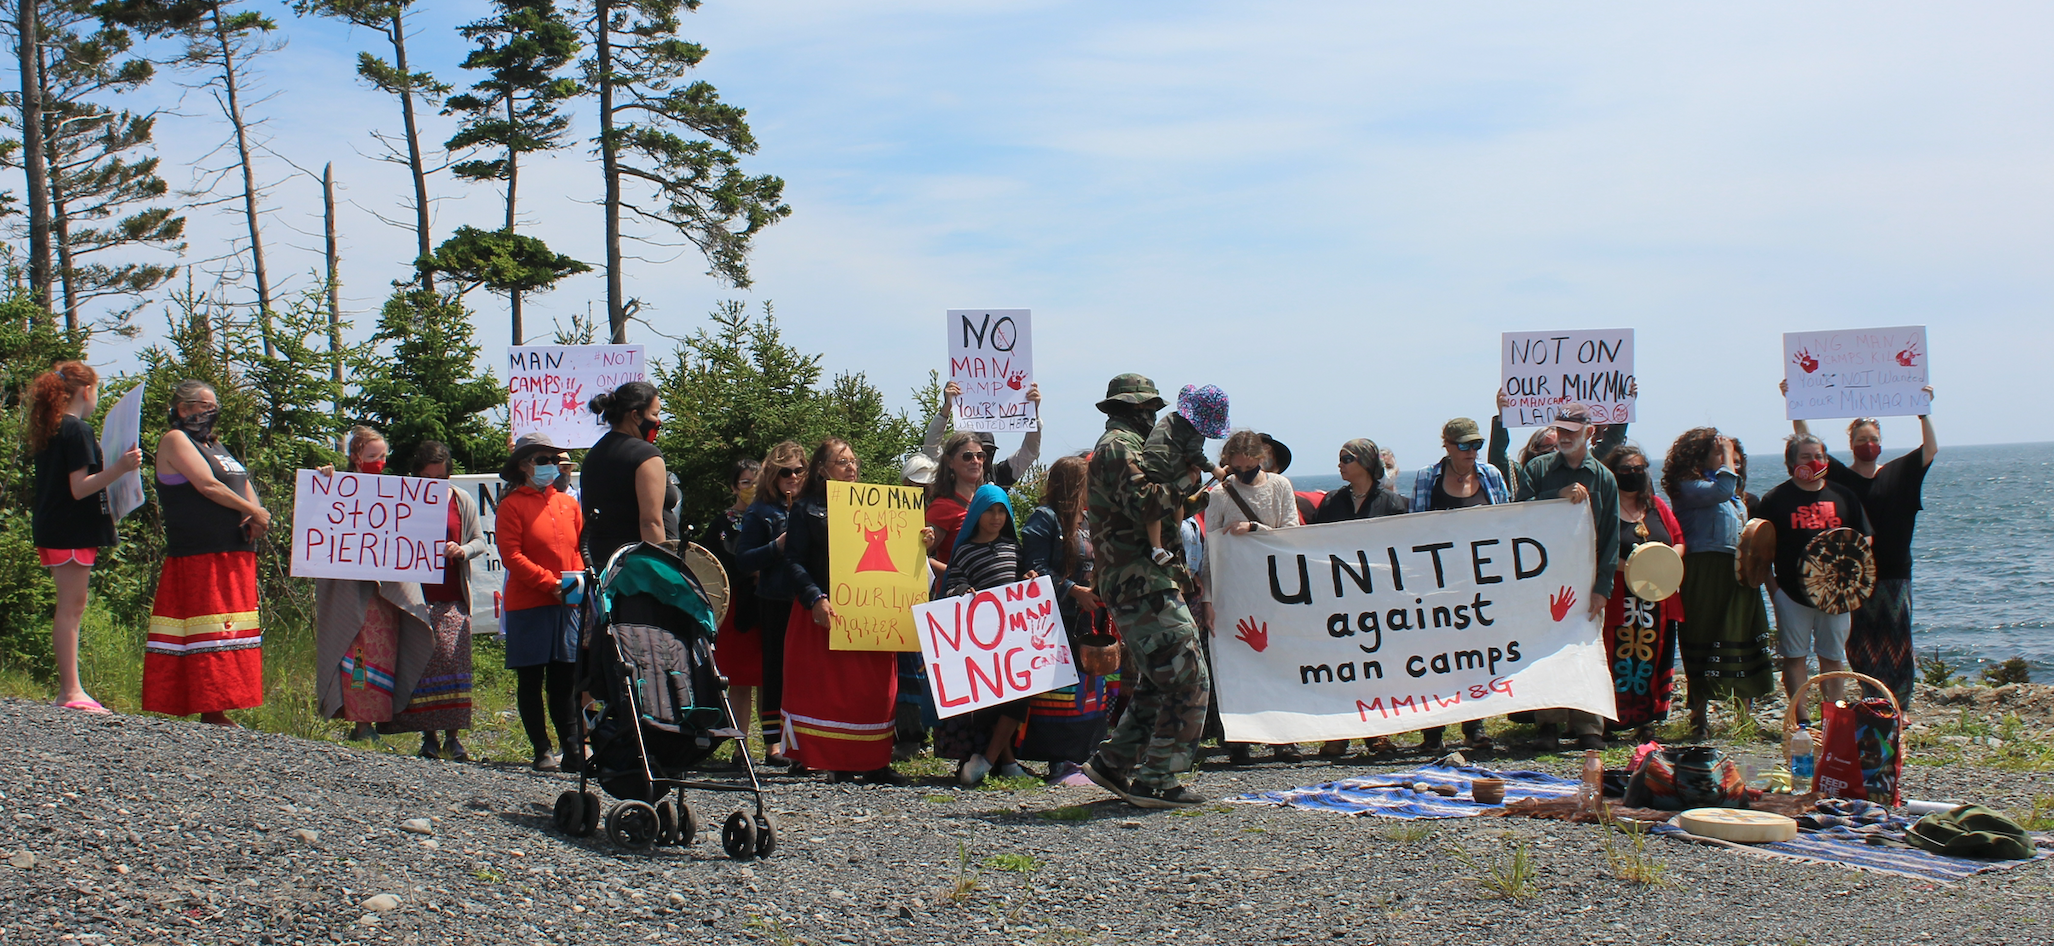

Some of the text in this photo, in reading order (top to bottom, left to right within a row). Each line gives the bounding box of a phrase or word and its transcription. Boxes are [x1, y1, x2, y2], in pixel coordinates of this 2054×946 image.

[962, 314, 1017, 352] NO
[1856, 334, 1895, 349] MAN
[510, 351, 564, 371] MAN
[1511, 337, 1622, 365] NOT ON
[1824, 348, 1900, 365] CAMPS KIL
[951, 355, 1010, 379] MAN
[1842, 370, 1874, 385] NOT
[509, 373, 561, 394] CAMPS
[596, 372, 618, 388] ON
[957, 380, 1004, 397] CAMP
[1506, 375, 1551, 396] OUR
[999, 401, 1030, 418] NOT
[1520, 396, 1546, 408] MAN
[1809, 395, 1834, 406] OUR
[954, 418, 1036, 430] WANTED HERE
[312, 475, 440, 505] NO LNG
[888, 487, 924, 510] MAN
[853, 509, 908, 533] CAMPS
[1790, 511, 1842, 530] here
[1267, 537, 1549, 605] UNITED
[835, 582, 888, 608] OUR
[1005, 581, 1041, 602] NO
[926, 591, 1006, 659] NO
[1009, 599, 1052, 632] MAN
[1326, 592, 1496, 654] against
[1299, 639, 1523, 685] man camps
[931, 647, 1032, 708] LNG
[1818, 782, 1840, 797] THE
[1820, 774, 1849, 790] FEED
